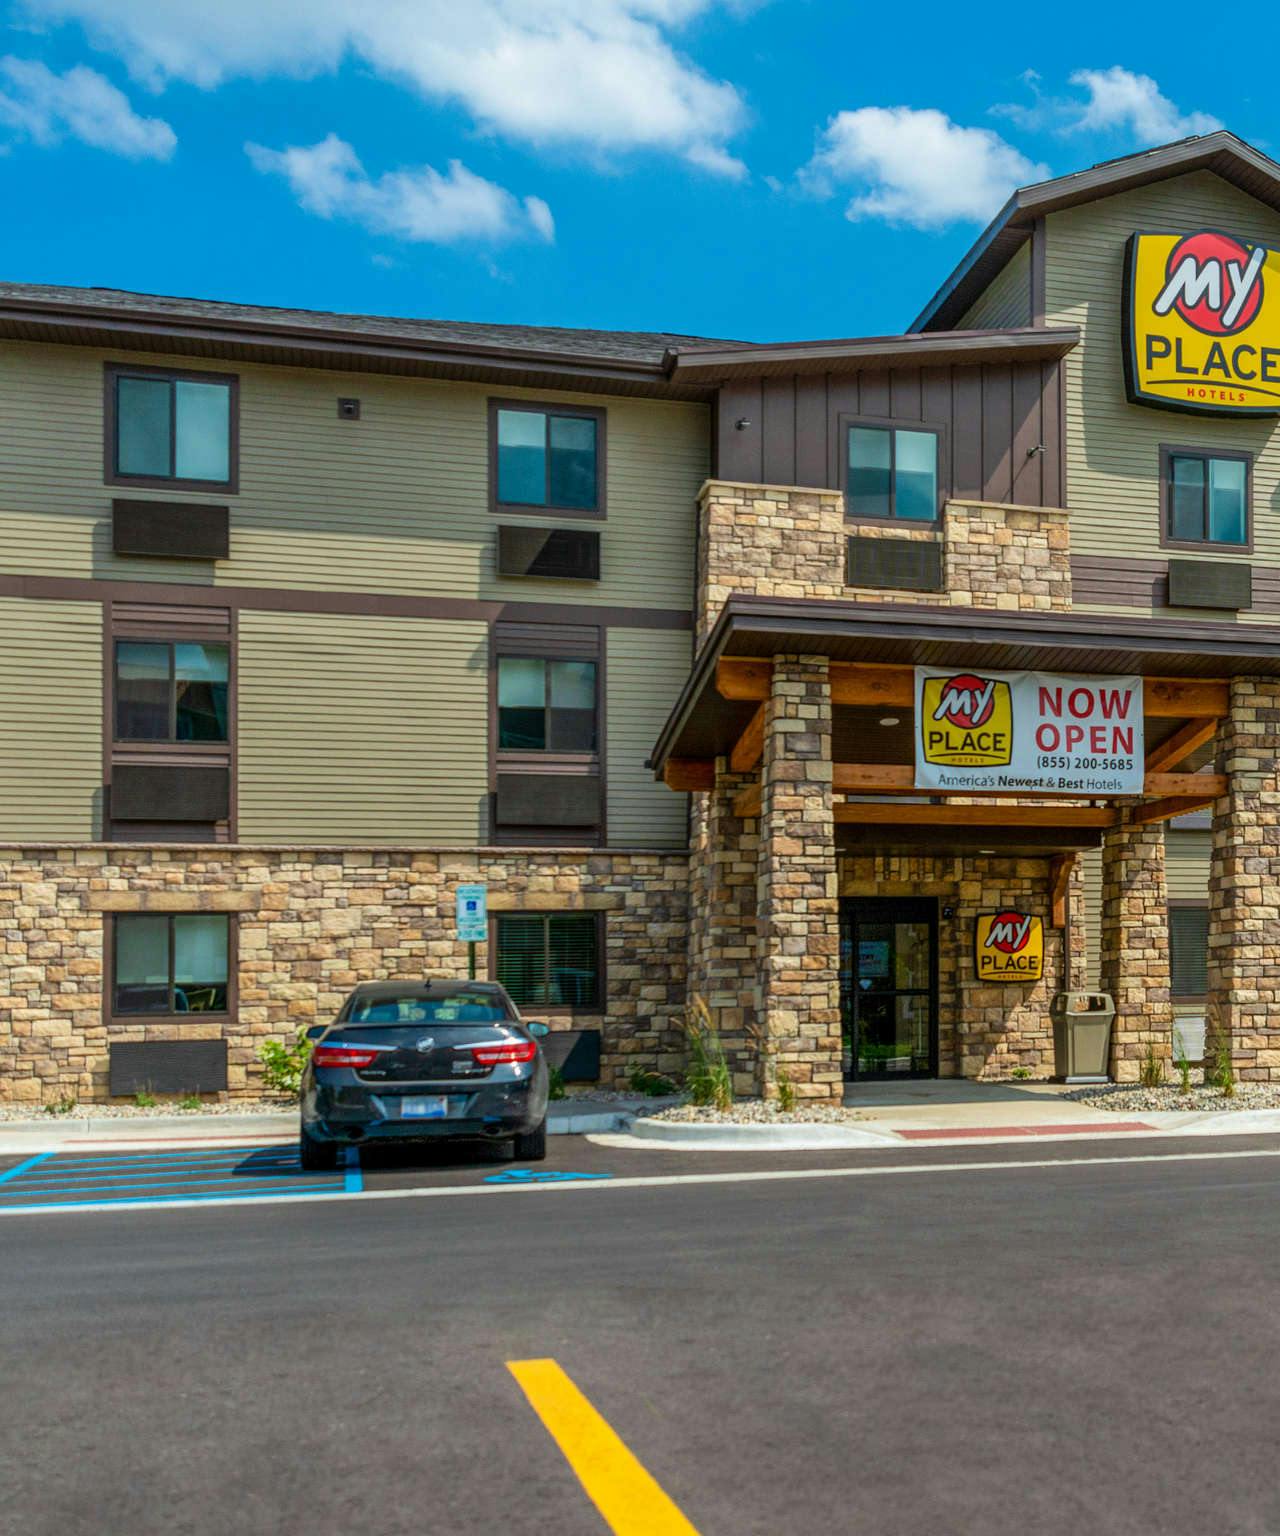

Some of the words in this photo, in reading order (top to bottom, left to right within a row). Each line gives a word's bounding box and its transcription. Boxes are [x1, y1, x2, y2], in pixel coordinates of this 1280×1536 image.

[1187, 388, 1245, 402] HOTELS
[1039, 687, 1132, 719] NOW
[929, 731, 1006, 752] PLACE
[1035, 723, 1133, 755] OPEN
[1037, 756, 1070, 769] (855)
[1074, 757, 1133, 770] 200-5685
[938, 774, 995, 787] America's
[998, 776, 1043, 787] Newest
[1046, 777, 1055, 787] &
[1058, 777, 1083, 789] Best
[1086, 778, 1122, 790] Hotels
[981, 955, 1038, 970] PLACE
